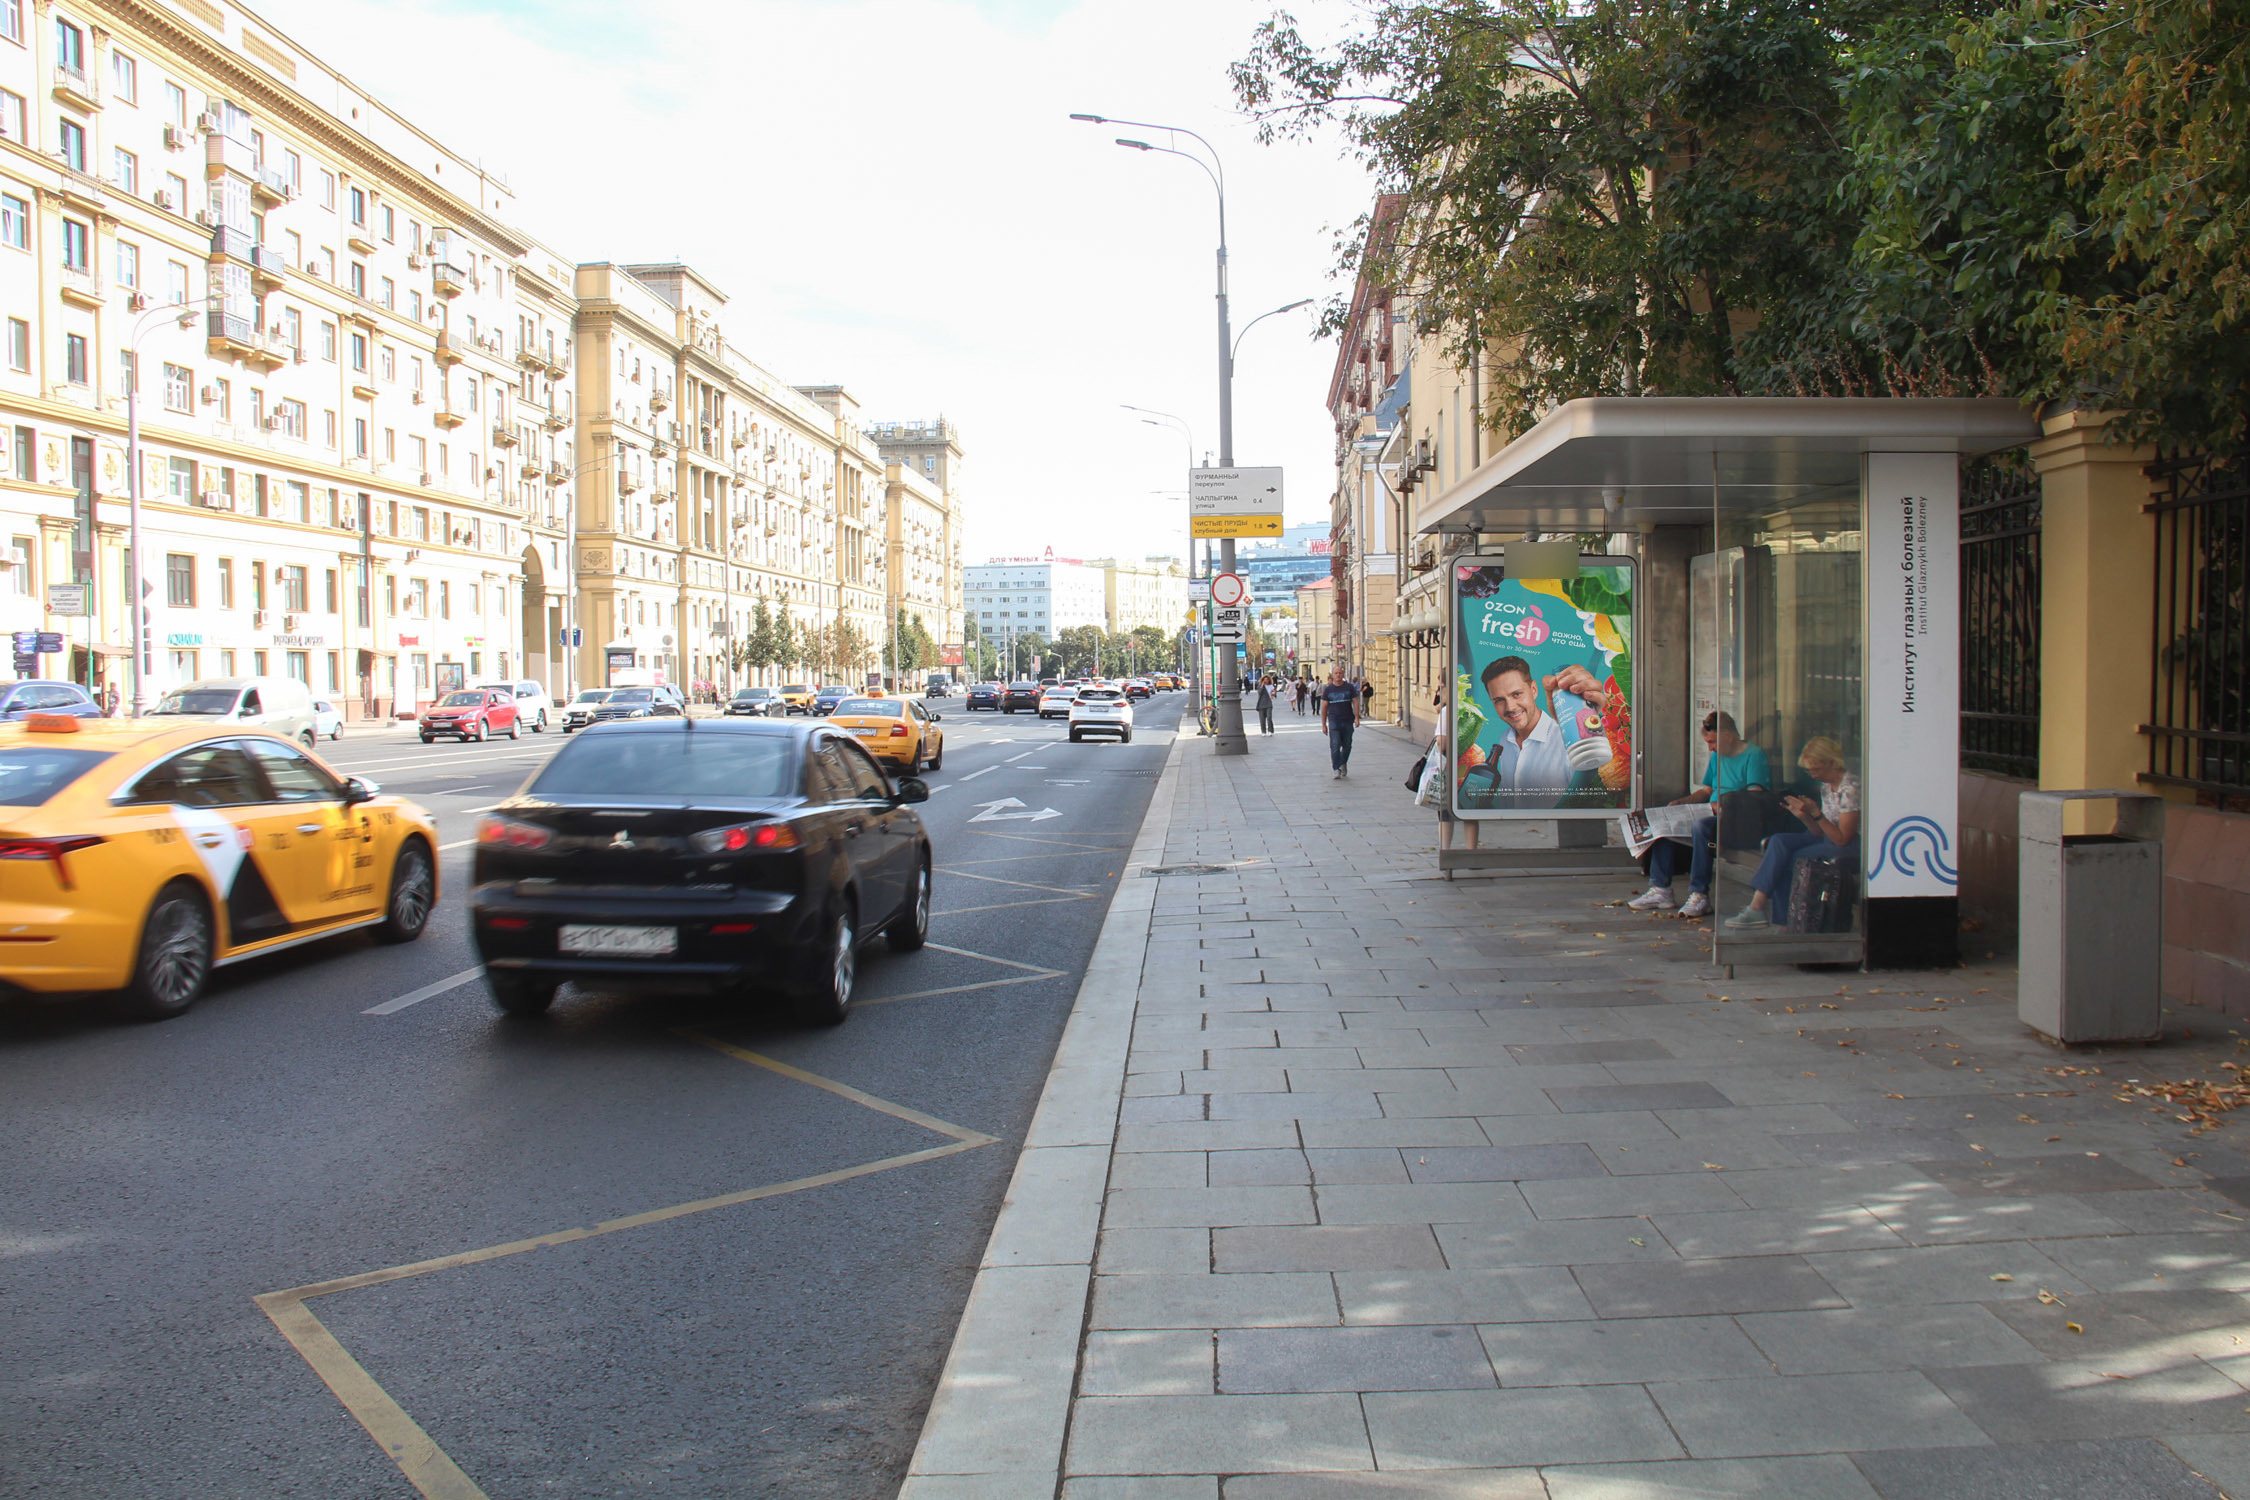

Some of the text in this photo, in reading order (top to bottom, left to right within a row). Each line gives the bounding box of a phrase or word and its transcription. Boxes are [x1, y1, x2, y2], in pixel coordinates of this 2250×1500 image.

[1194, 472, 1240, 480] ФУРМАННЫЙ
[1918, 496, 1928, 635] Institut Glaznykh Bolezney
[1485, 601, 1526, 615] OZON
[1901, 496, 1917, 713] Институт глазных болезней
[1481, 613, 1541, 641] fresh
